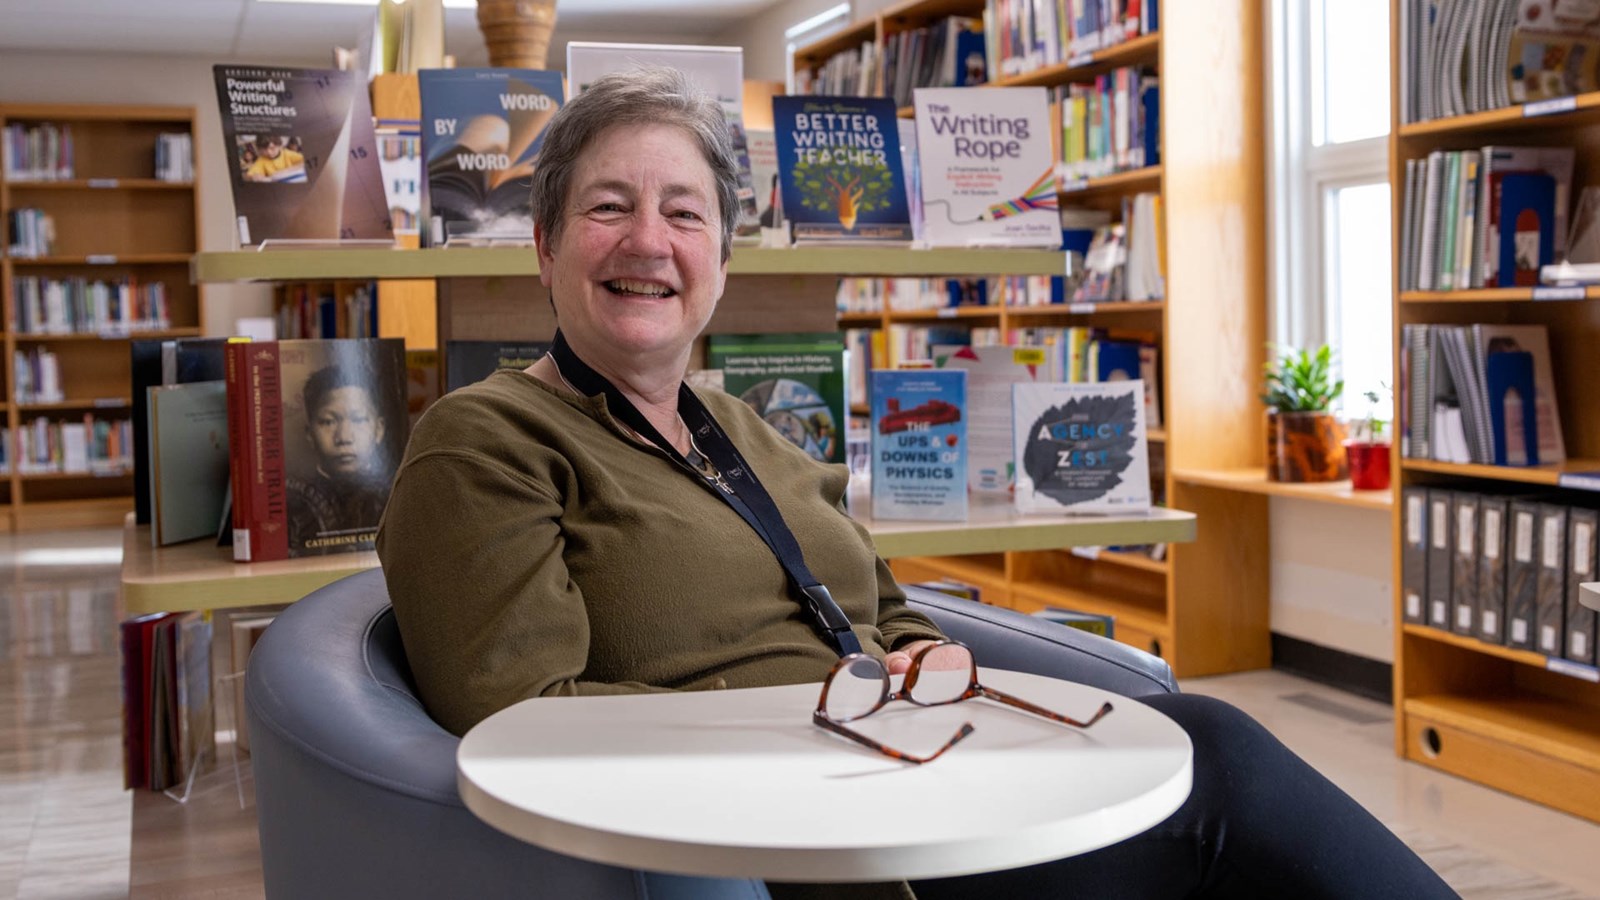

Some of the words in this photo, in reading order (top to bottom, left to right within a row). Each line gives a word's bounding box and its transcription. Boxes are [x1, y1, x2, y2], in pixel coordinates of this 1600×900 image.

[227, 79, 285, 92] Powerful
[228, 91, 277, 106] Writing
[500, 93, 551, 110] WORD
[230, 102, 297, 117] Structures
[927, 103, 949, 114] The
[434, 118, 457, 135] BY
[795, 113, 879, 131] BETTER
[931, 114, 1030, 140] Writing
[792, 130, 885, 149] WRITING
[350, 147, 367, 160] 15
[793, 148, 887, 166] TEACHER
[955, 137, 1021, 160] Rope
[457, 153, 510, 170] WORD
[725, 356, 758, 366] Learning
[783, 365, 804, 373] Social
[806, 364, 834, 373] Studies
[263, 362, 277, 399] THE
[254, 406, 262, 435] Chinese
[906, 421, 931, 433] THE
[265, 406, 279, 459] PAPER
[1037, 423, 1125, 441] AGENCY
[898, 436, 928, 447] UPS
[931, 436, 941, 448] &
[881, 451, 938, 463] DOWNS
[942, 451, 959, 464] OF
[1057, 450, 1109, 467] ZEST
[886, 467, 954, 479] PHYSICS
[267, 468, 282, 520] TRAIL
[304, 534, 357, 549] CATHERINE
